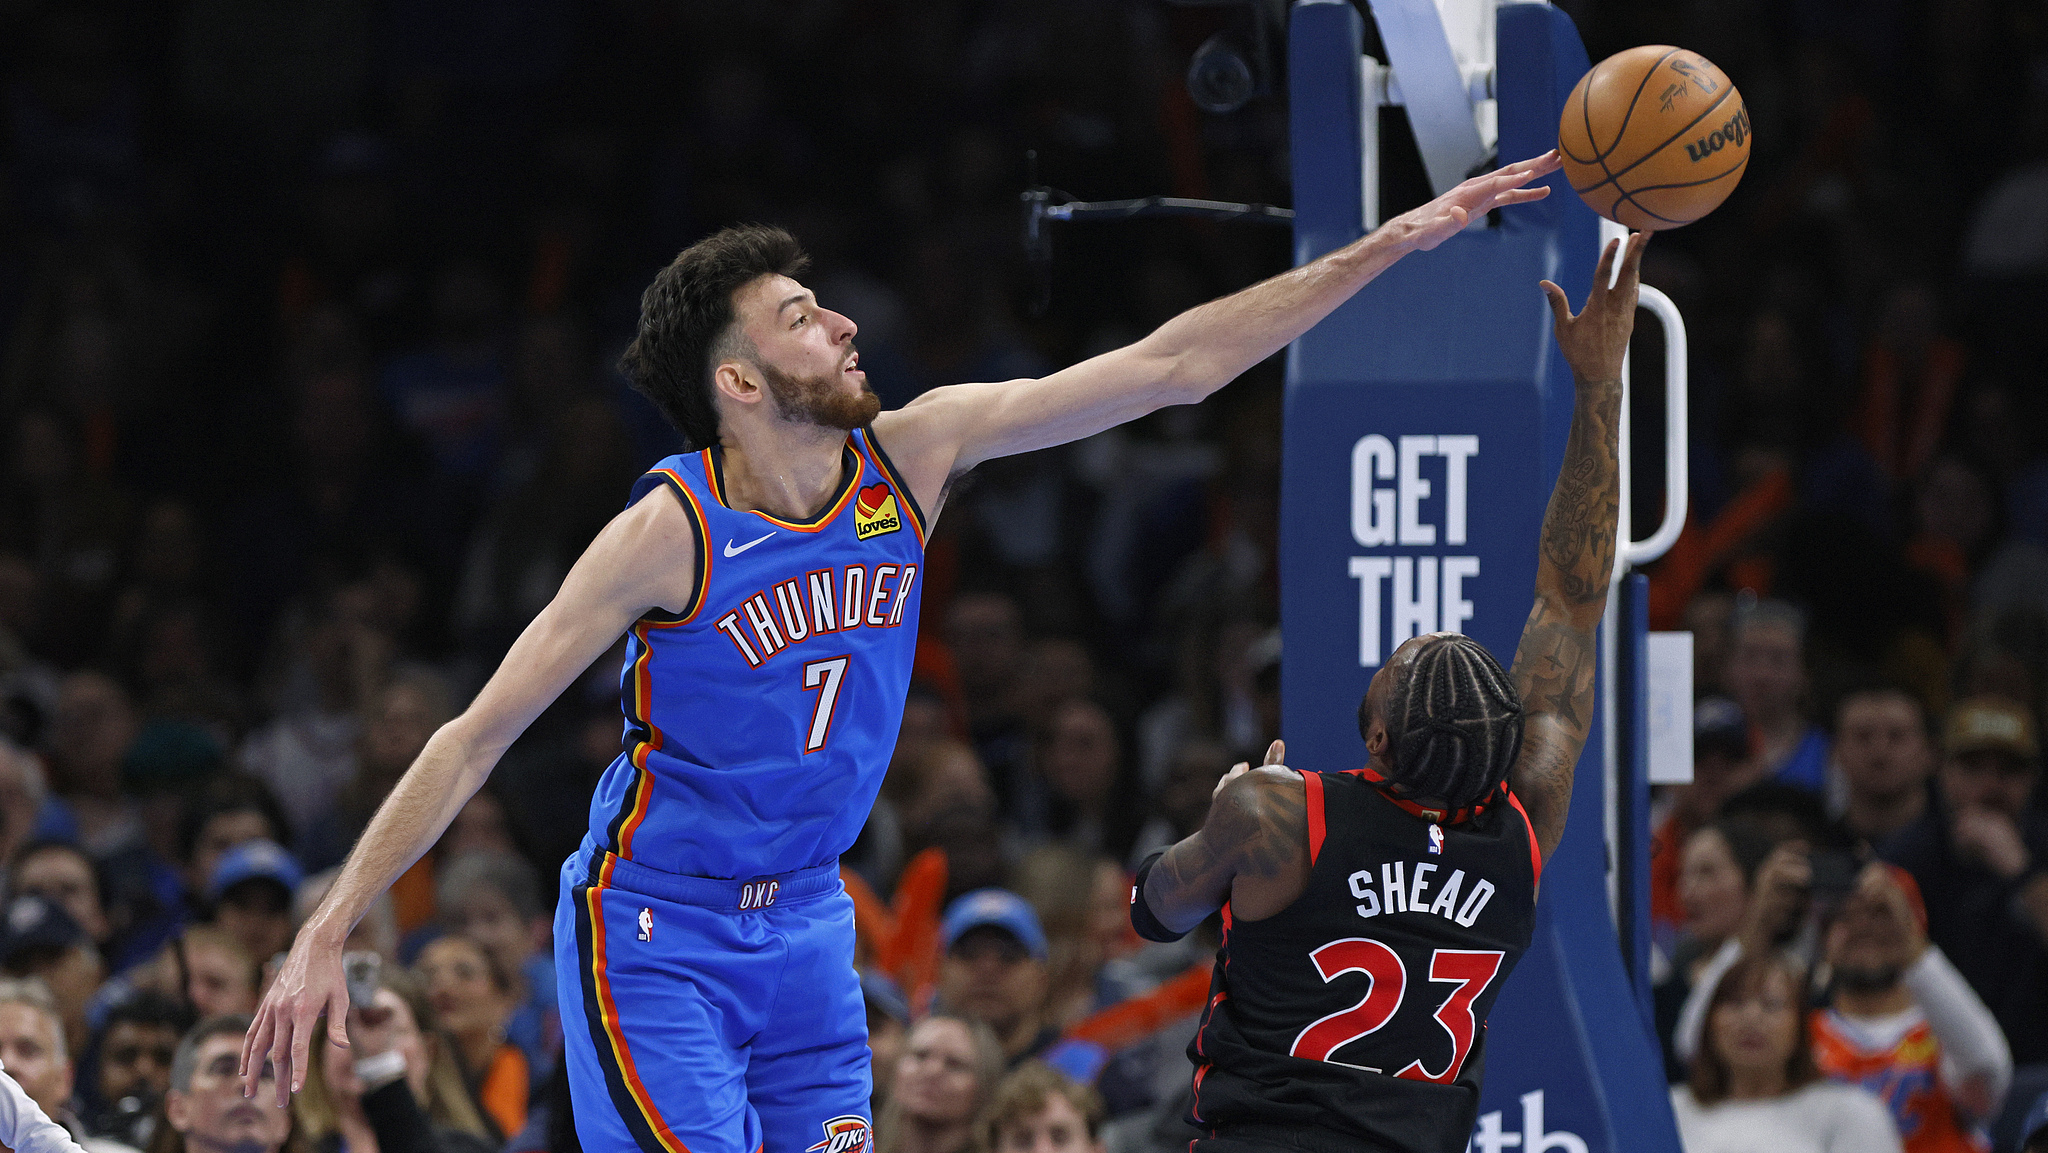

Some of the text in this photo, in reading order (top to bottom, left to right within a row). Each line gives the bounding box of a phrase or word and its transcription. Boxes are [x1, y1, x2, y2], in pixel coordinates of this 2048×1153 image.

[1351, 433, 1480, 548] GET
[713, 563, 918, 670] THUNDER
[802, 654, 851, 755] 7
[738, 879, 780, 911] OKC
[1348, 861, 1496, 928] SHEAD
[1289, 937, 1506, 1085] 23
[825, 1127, 865, 1153] OKC
